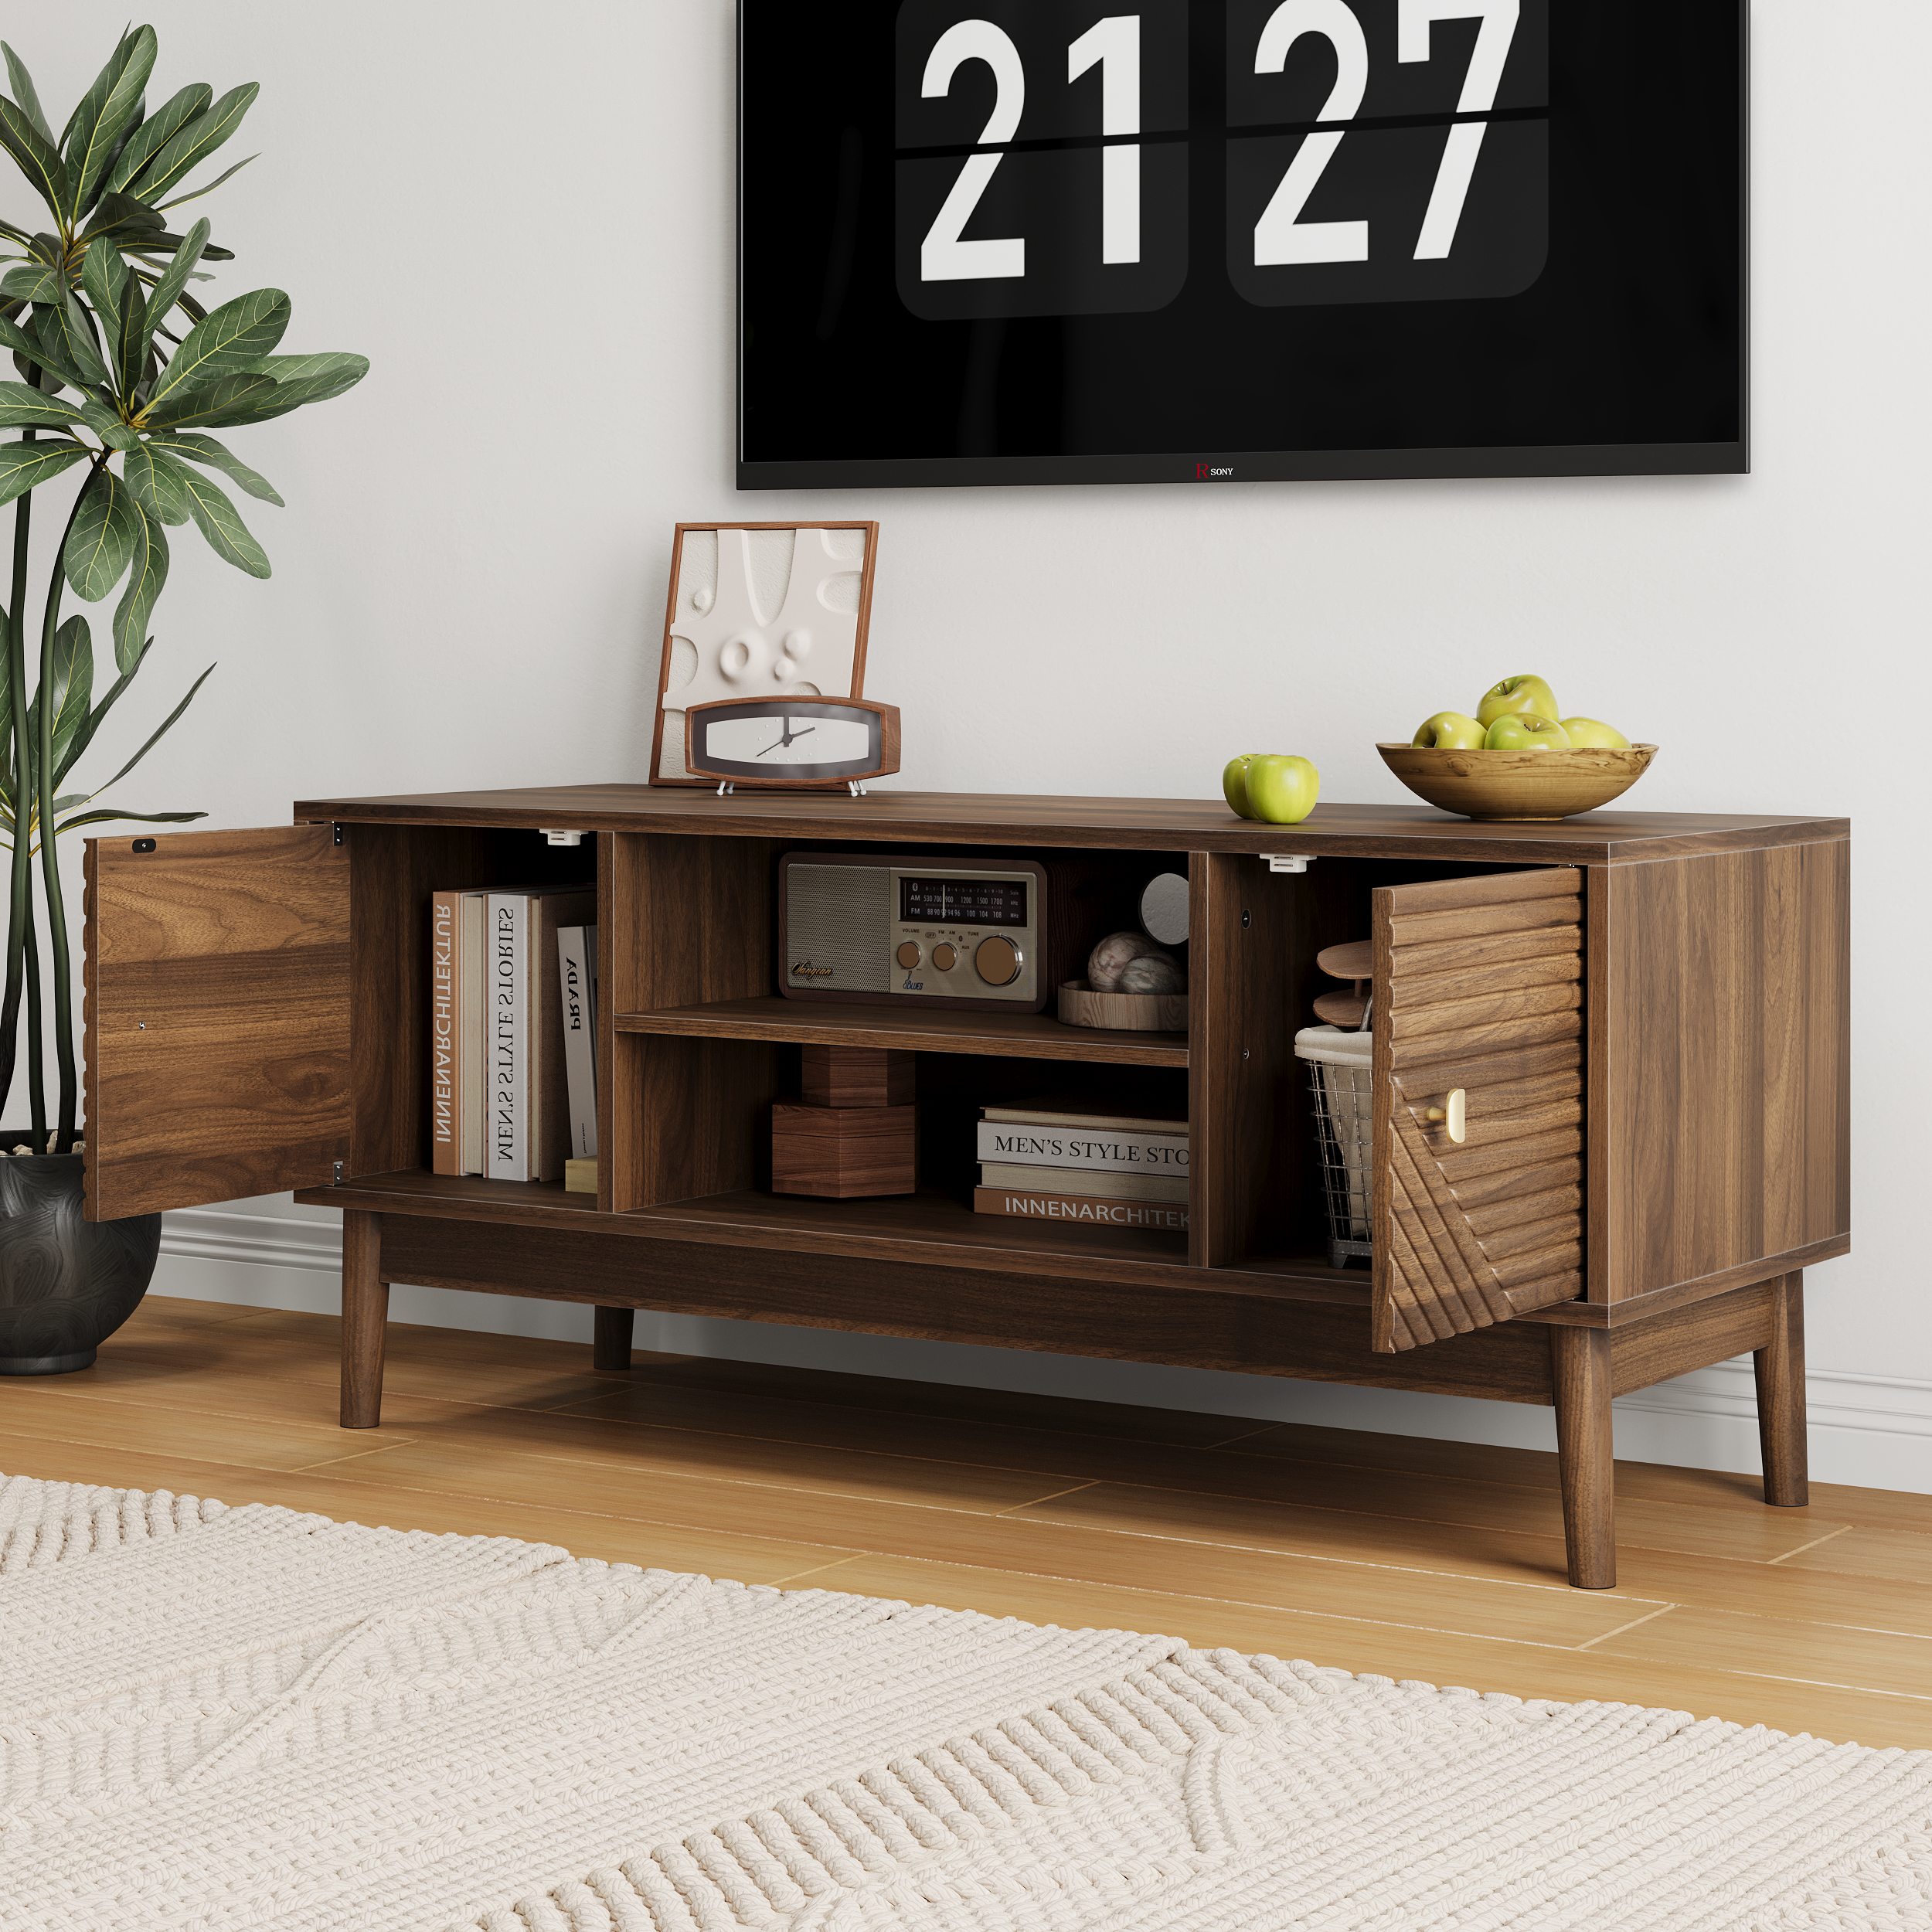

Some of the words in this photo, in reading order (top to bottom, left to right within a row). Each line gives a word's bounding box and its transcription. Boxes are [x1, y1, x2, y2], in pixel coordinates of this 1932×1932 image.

[920, 15, 1141, 281] 21
[1253, 0, 1521, 266] 27
[1196, 463, 1209, 478] R
[1210, 468, 1234, 476] SONY
[995, 1135, 1063, 1155] MEN'S
[1069, 1141, 1140, 1162] STYLE
[1147, 1147, 1189, 1165] STO
[1005, 1197, 1189, 1227] INNENARCHITEK
